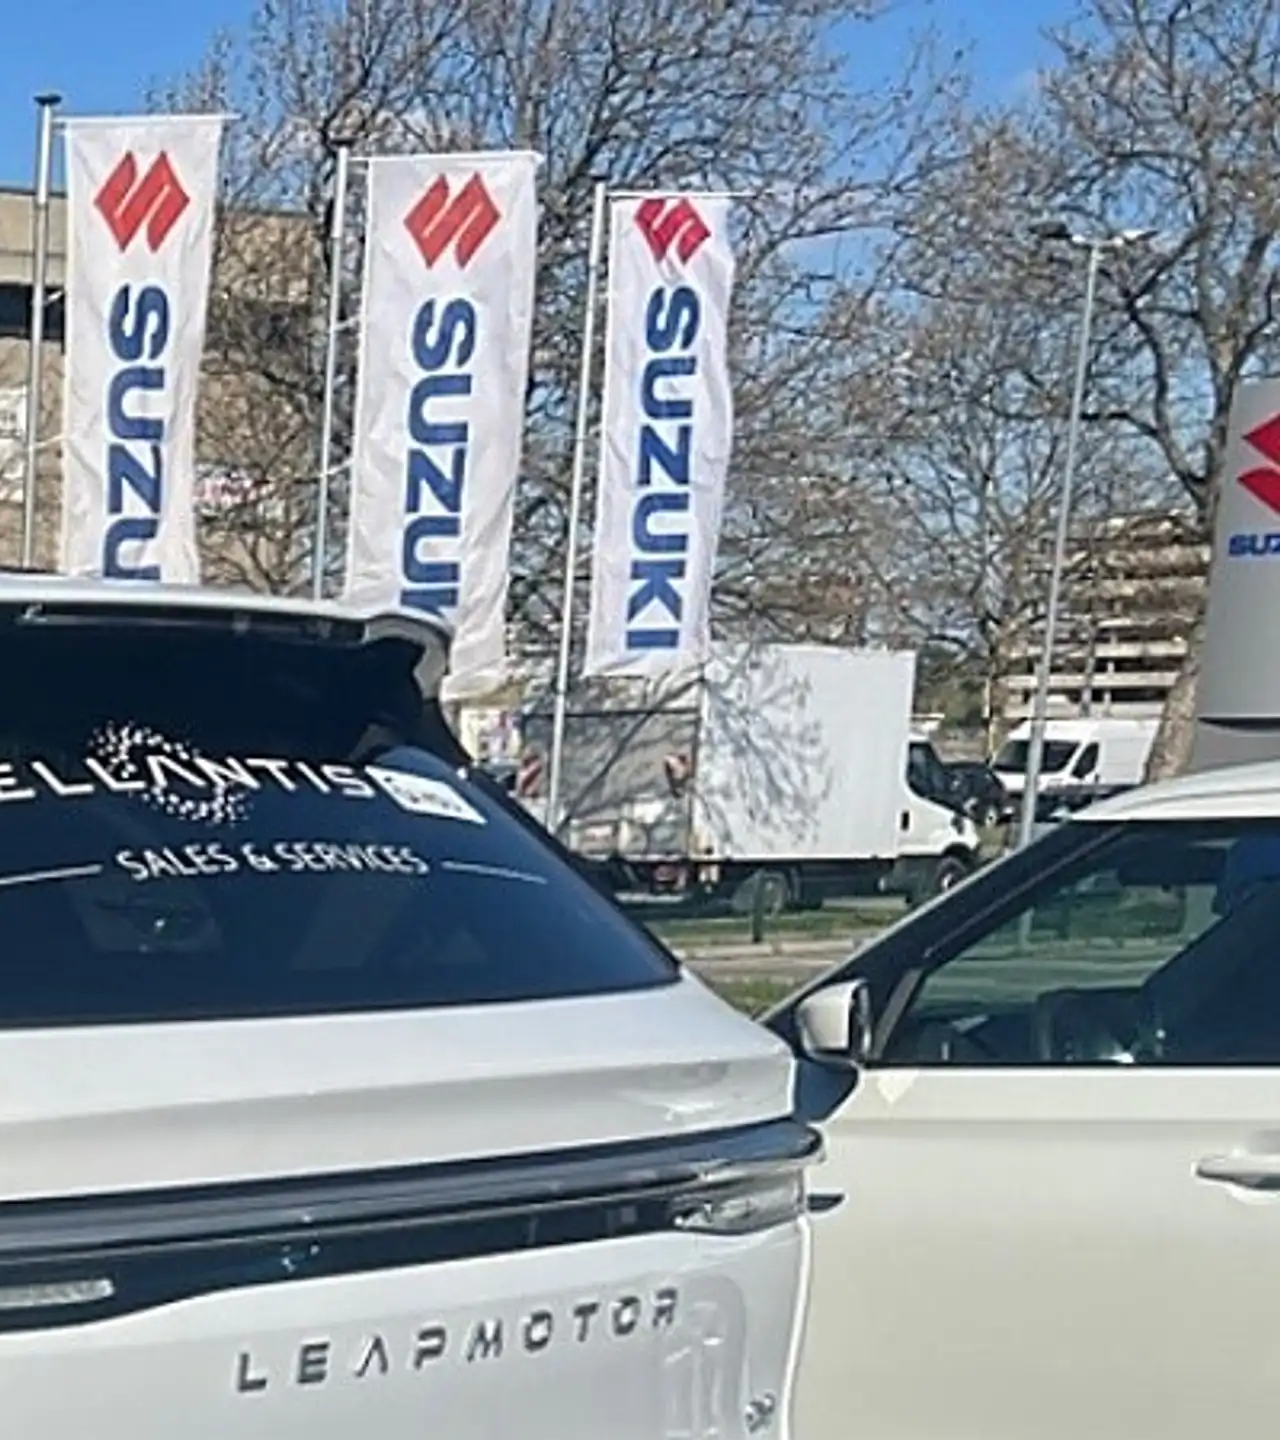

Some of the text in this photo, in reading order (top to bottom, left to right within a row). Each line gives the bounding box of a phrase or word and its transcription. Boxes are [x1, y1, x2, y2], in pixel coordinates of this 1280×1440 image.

[626, 286, 701, 650] SUZUKI
[116, 842, 430, 880] SALES & SERVICES
[236, 1287, 679, 1393] LEAPMOTOR
